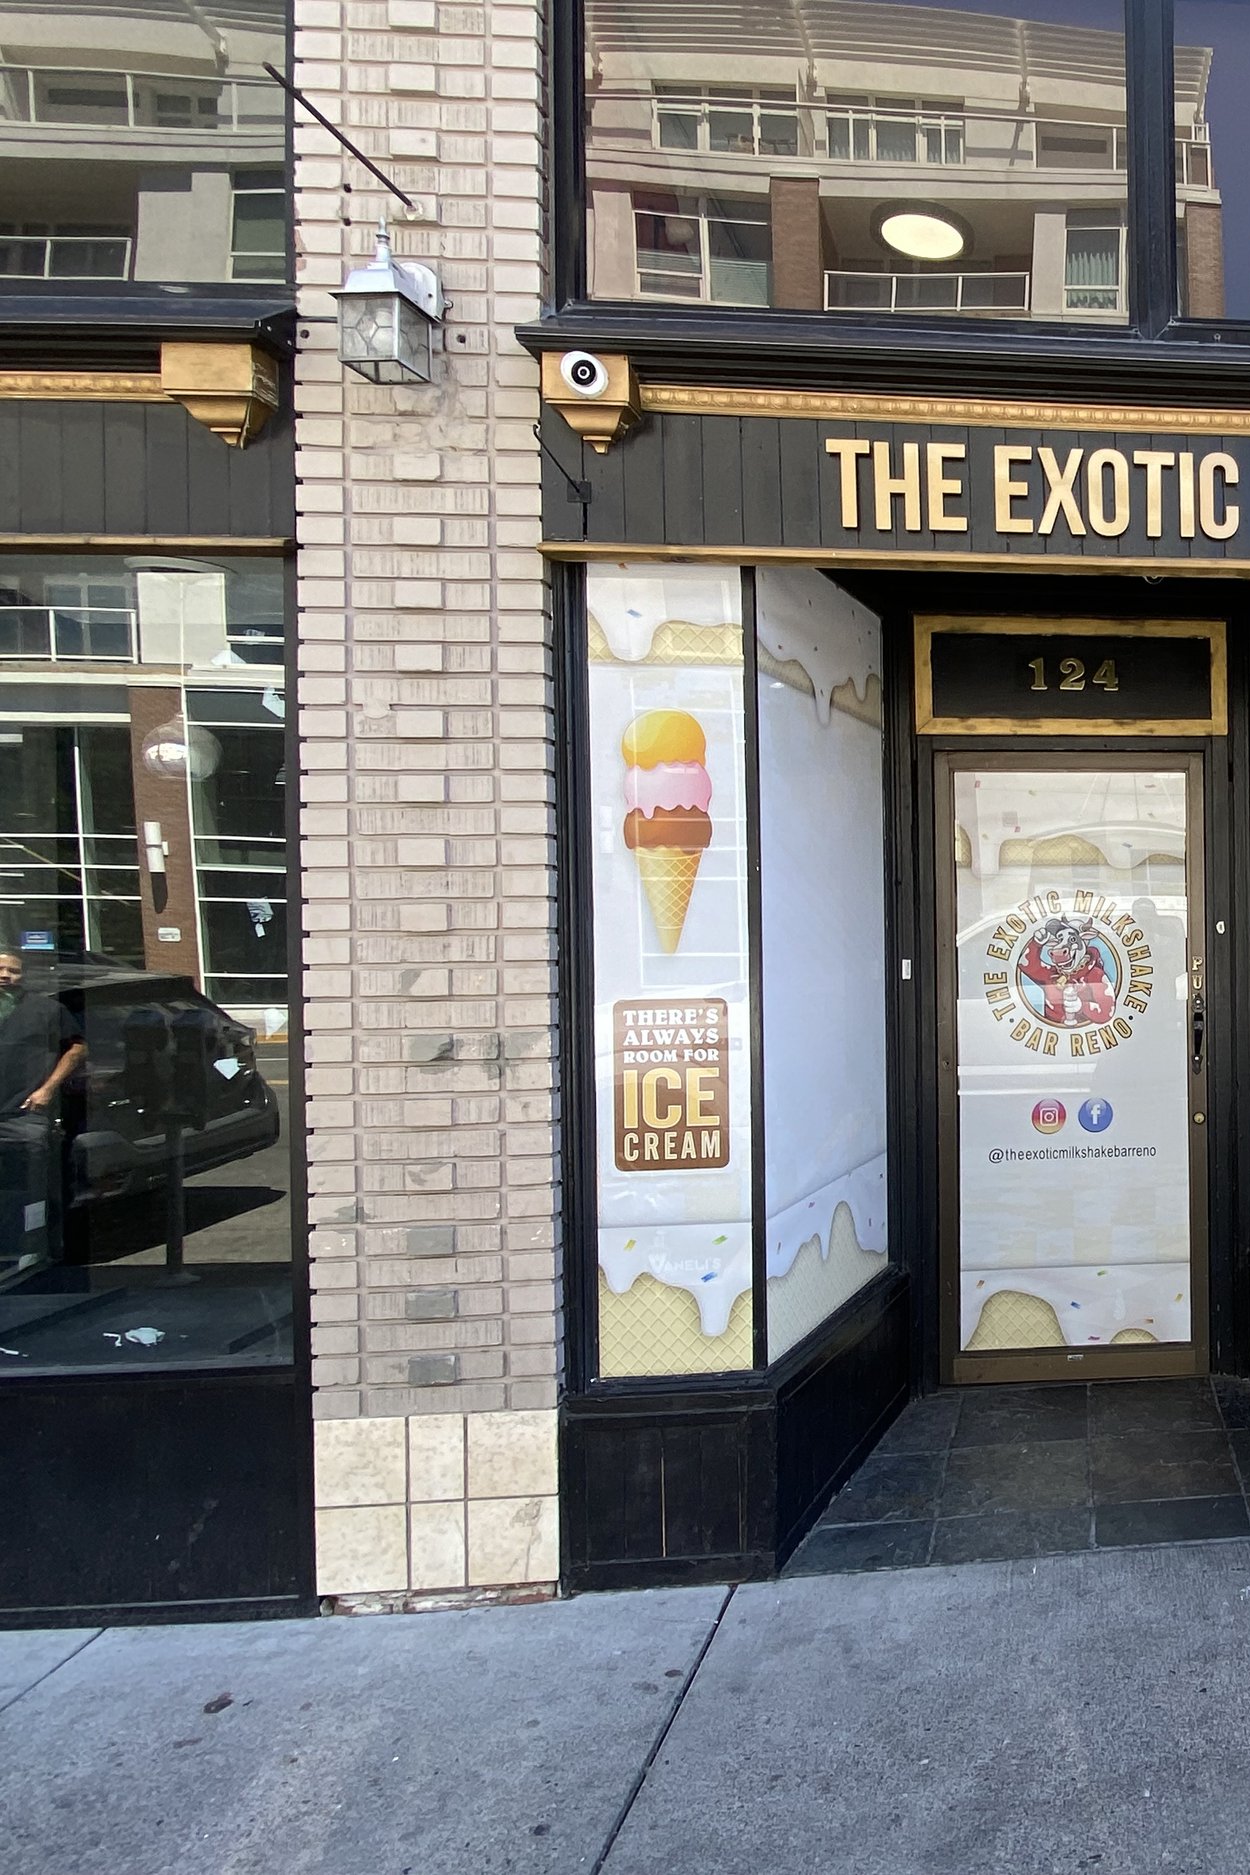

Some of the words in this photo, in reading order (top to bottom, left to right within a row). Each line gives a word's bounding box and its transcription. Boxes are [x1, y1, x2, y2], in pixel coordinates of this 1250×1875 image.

[825, 439, 968, 532] THE
[994, 445, 1239, 540] EXOTIC
[1028, 657, 1120, 692] 124
[987, 890, 1061, 961] EXOTIC
[1073, 889, 1154, 1013] MILKSHAKE
[983, 971, 1016, 1022] THE
[623, 1008, 719, 1026] THERE'S
[623, 1028, 719, 1046] ALWAYS
[623, 1049, 678, 1063] ROOM
[683, 1048, 719, 1062] FOR
[1010, 1018, 1059, 1056] BAR
[1071, 1017, 1133, 1057] RENO
[623, 1067, 720, 1129] ICE
[624, 1130, 721, 1161] CREAM
[988, 1146, 1156, 1164] @theexoticmilkshakebarreno
